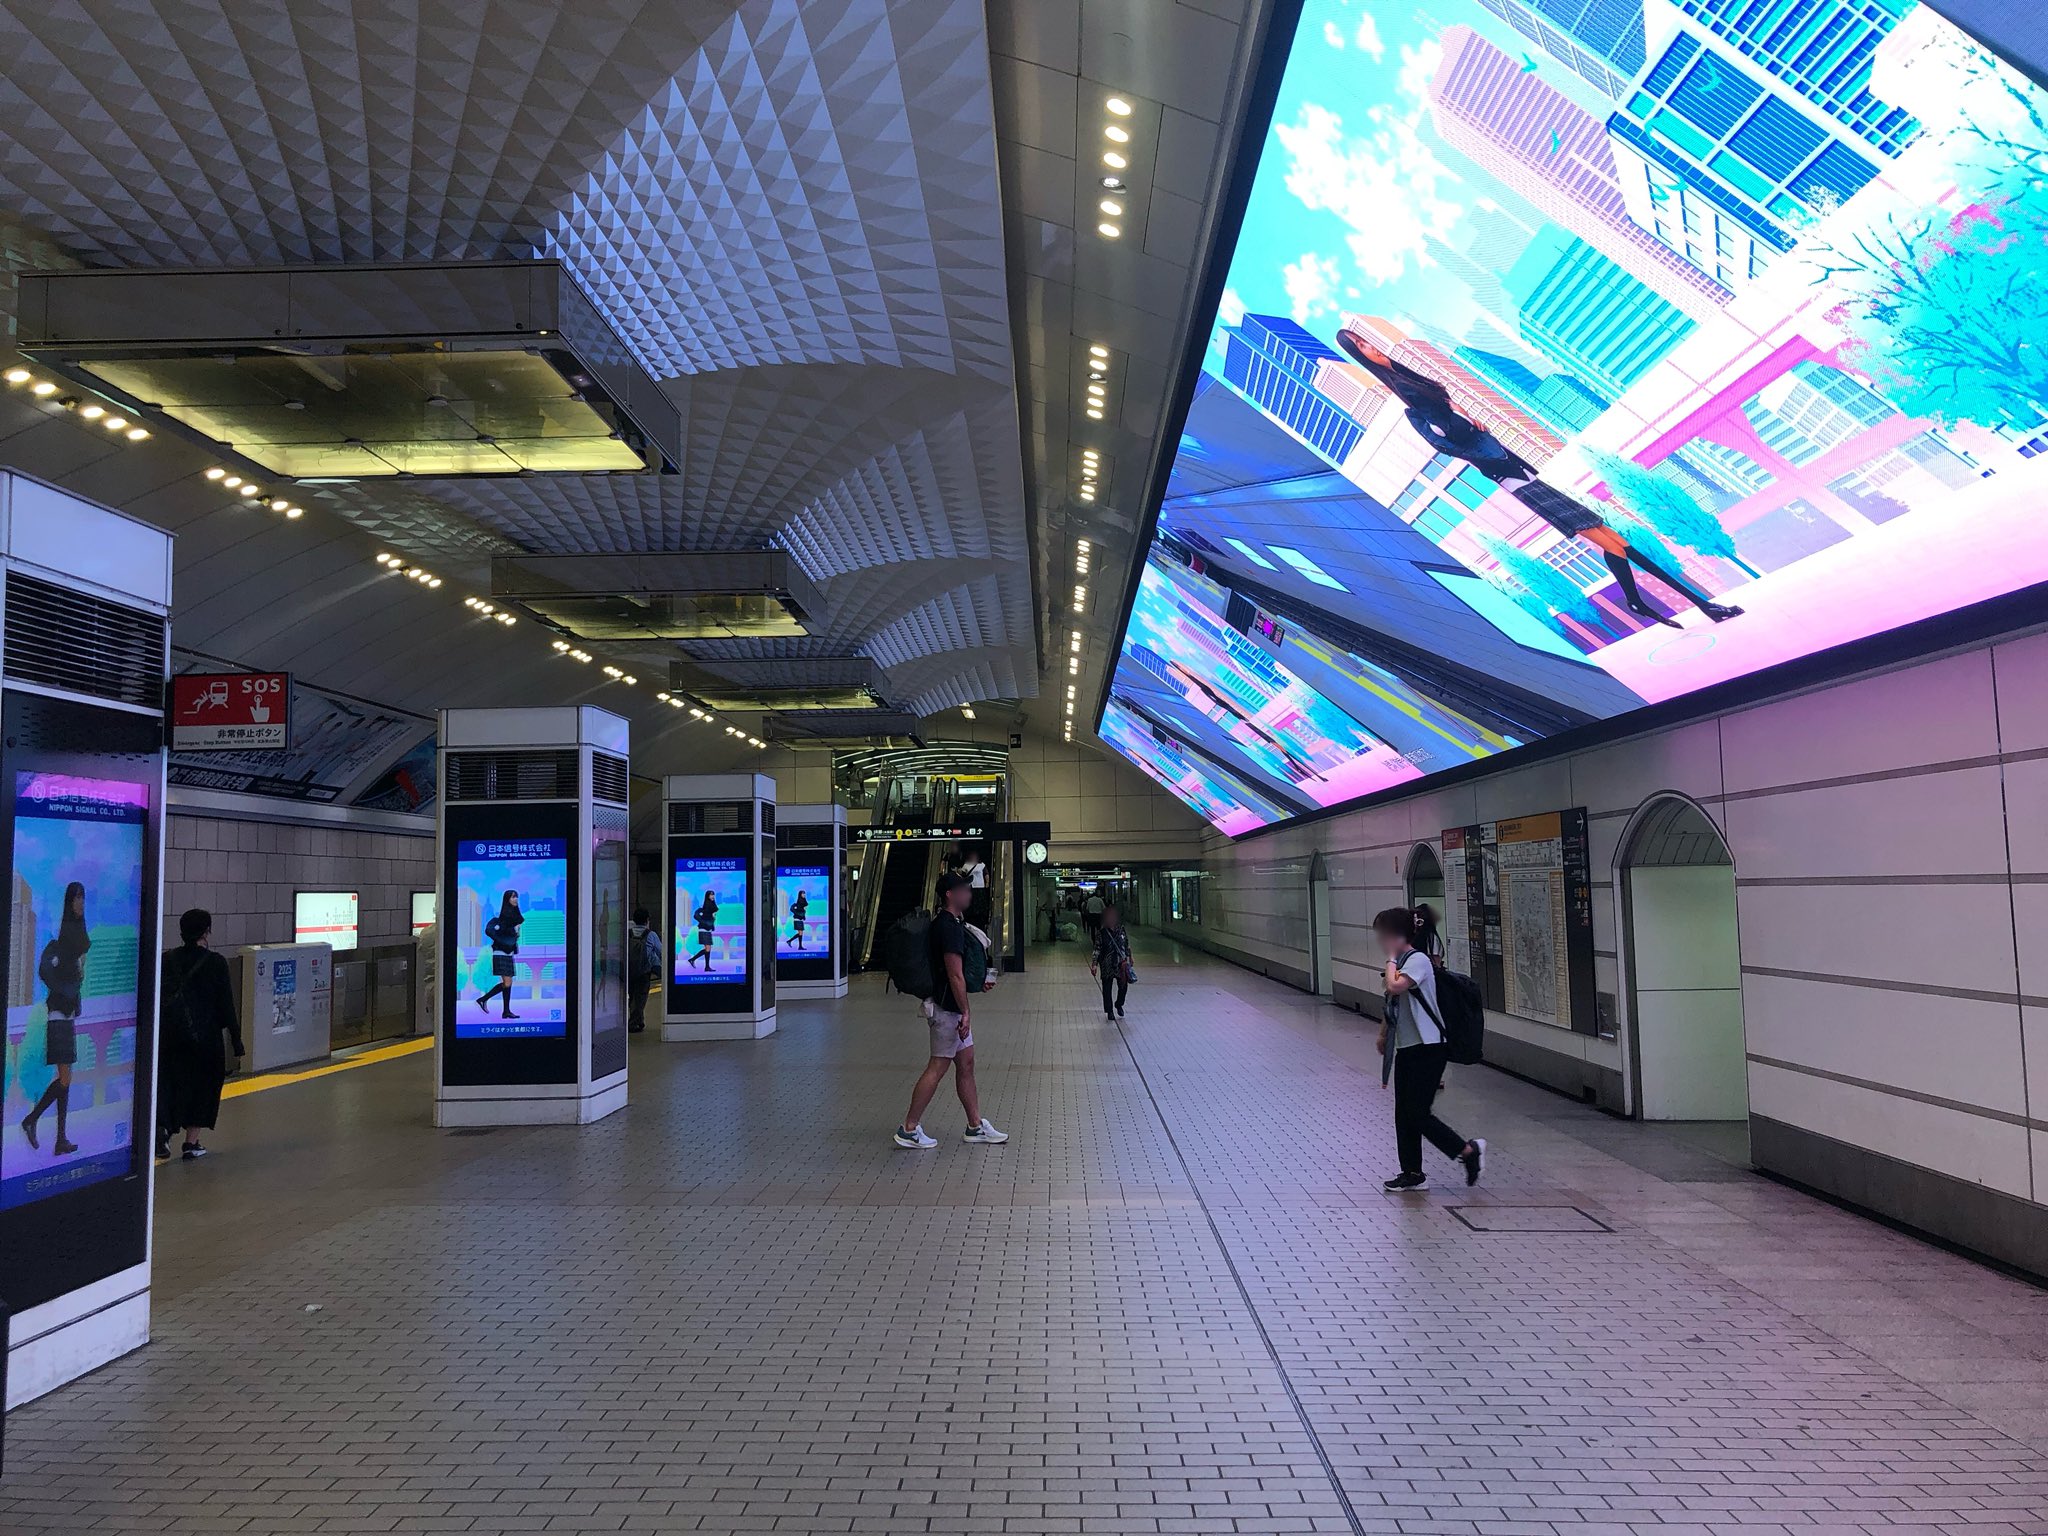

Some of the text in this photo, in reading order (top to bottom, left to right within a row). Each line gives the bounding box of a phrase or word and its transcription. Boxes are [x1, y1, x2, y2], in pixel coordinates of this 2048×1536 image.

[242, 679, 280, 693] SOS
[218, 728, 281, 738] 非常停止ボタン
[49, 785, 126, 807] 日本信号株式会社
[49, 803, 73, 813] NIPPON
[75, 805, 97, 815] SIGNAL
[113, 808, 126, 817] LTD.
[489, 844, 551, 852] 日本信号株式会社
[278, 964, 292, 976] 2025
